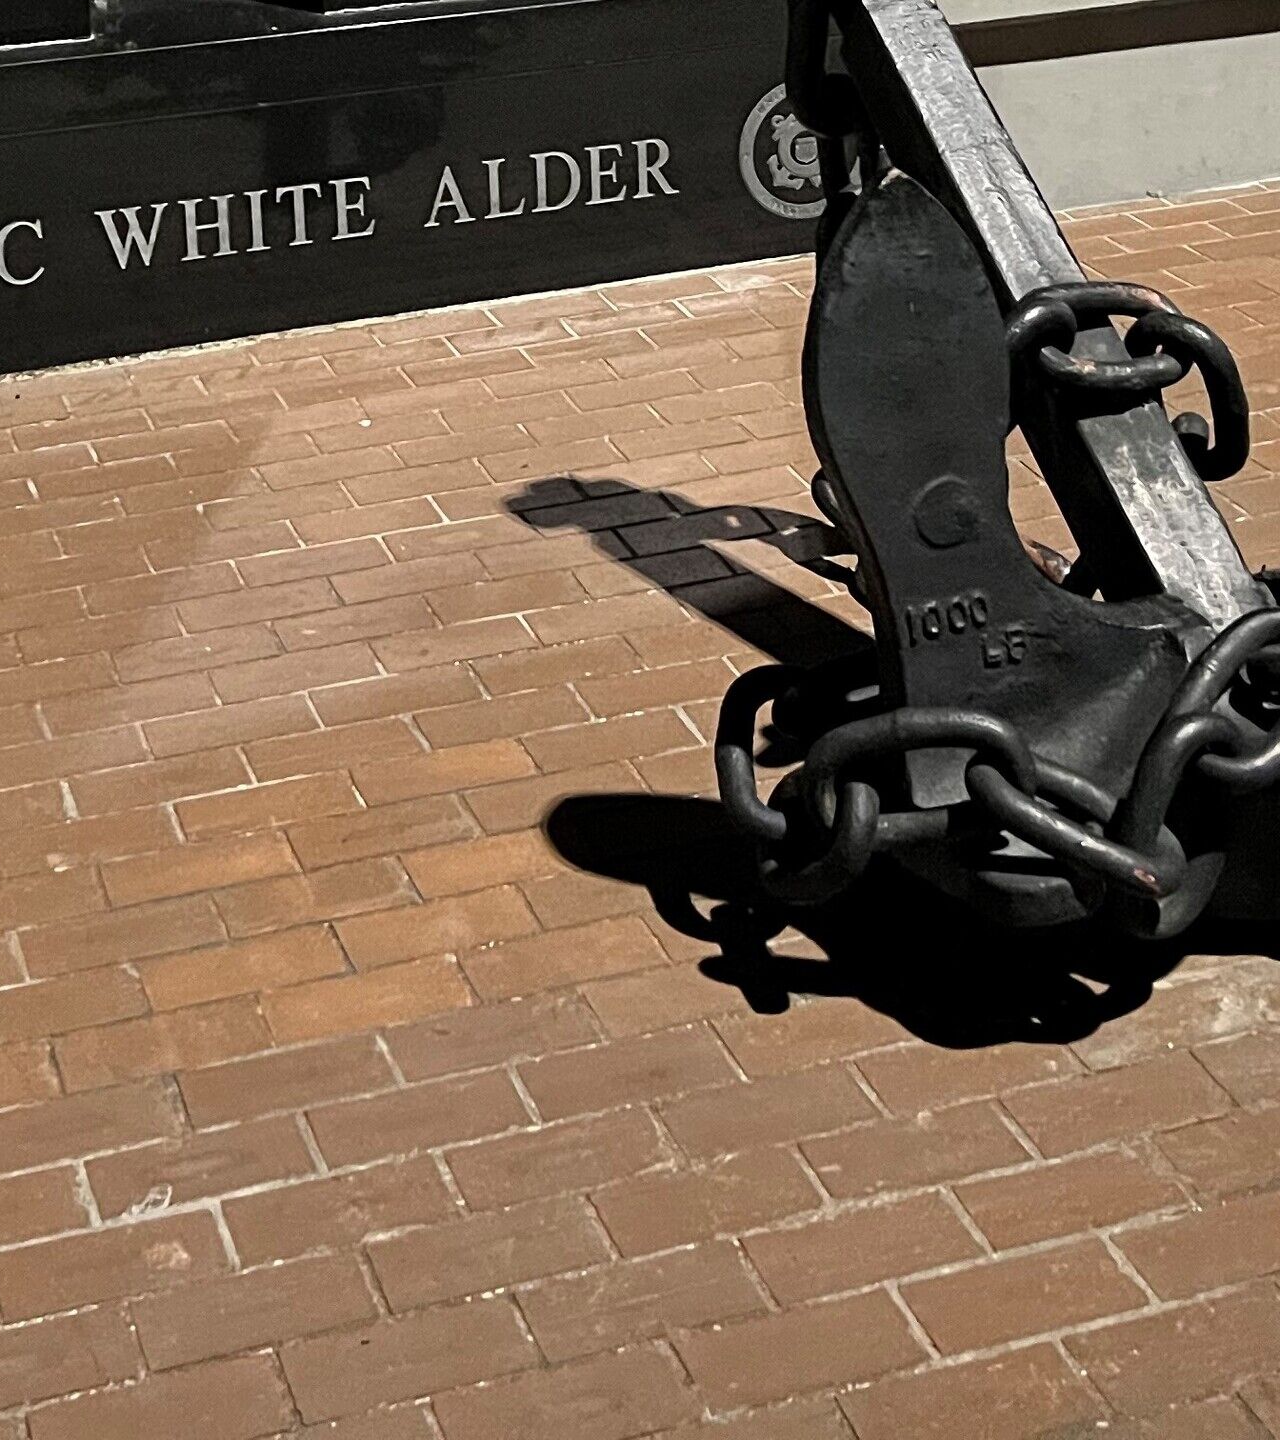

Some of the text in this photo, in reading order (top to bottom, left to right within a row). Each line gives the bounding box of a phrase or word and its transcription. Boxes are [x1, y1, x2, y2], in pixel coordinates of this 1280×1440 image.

[93, 176, 376, 270] WHITE
[424, 138, 680, 228] ALDER
[905, 591, 988, 648] 1000
